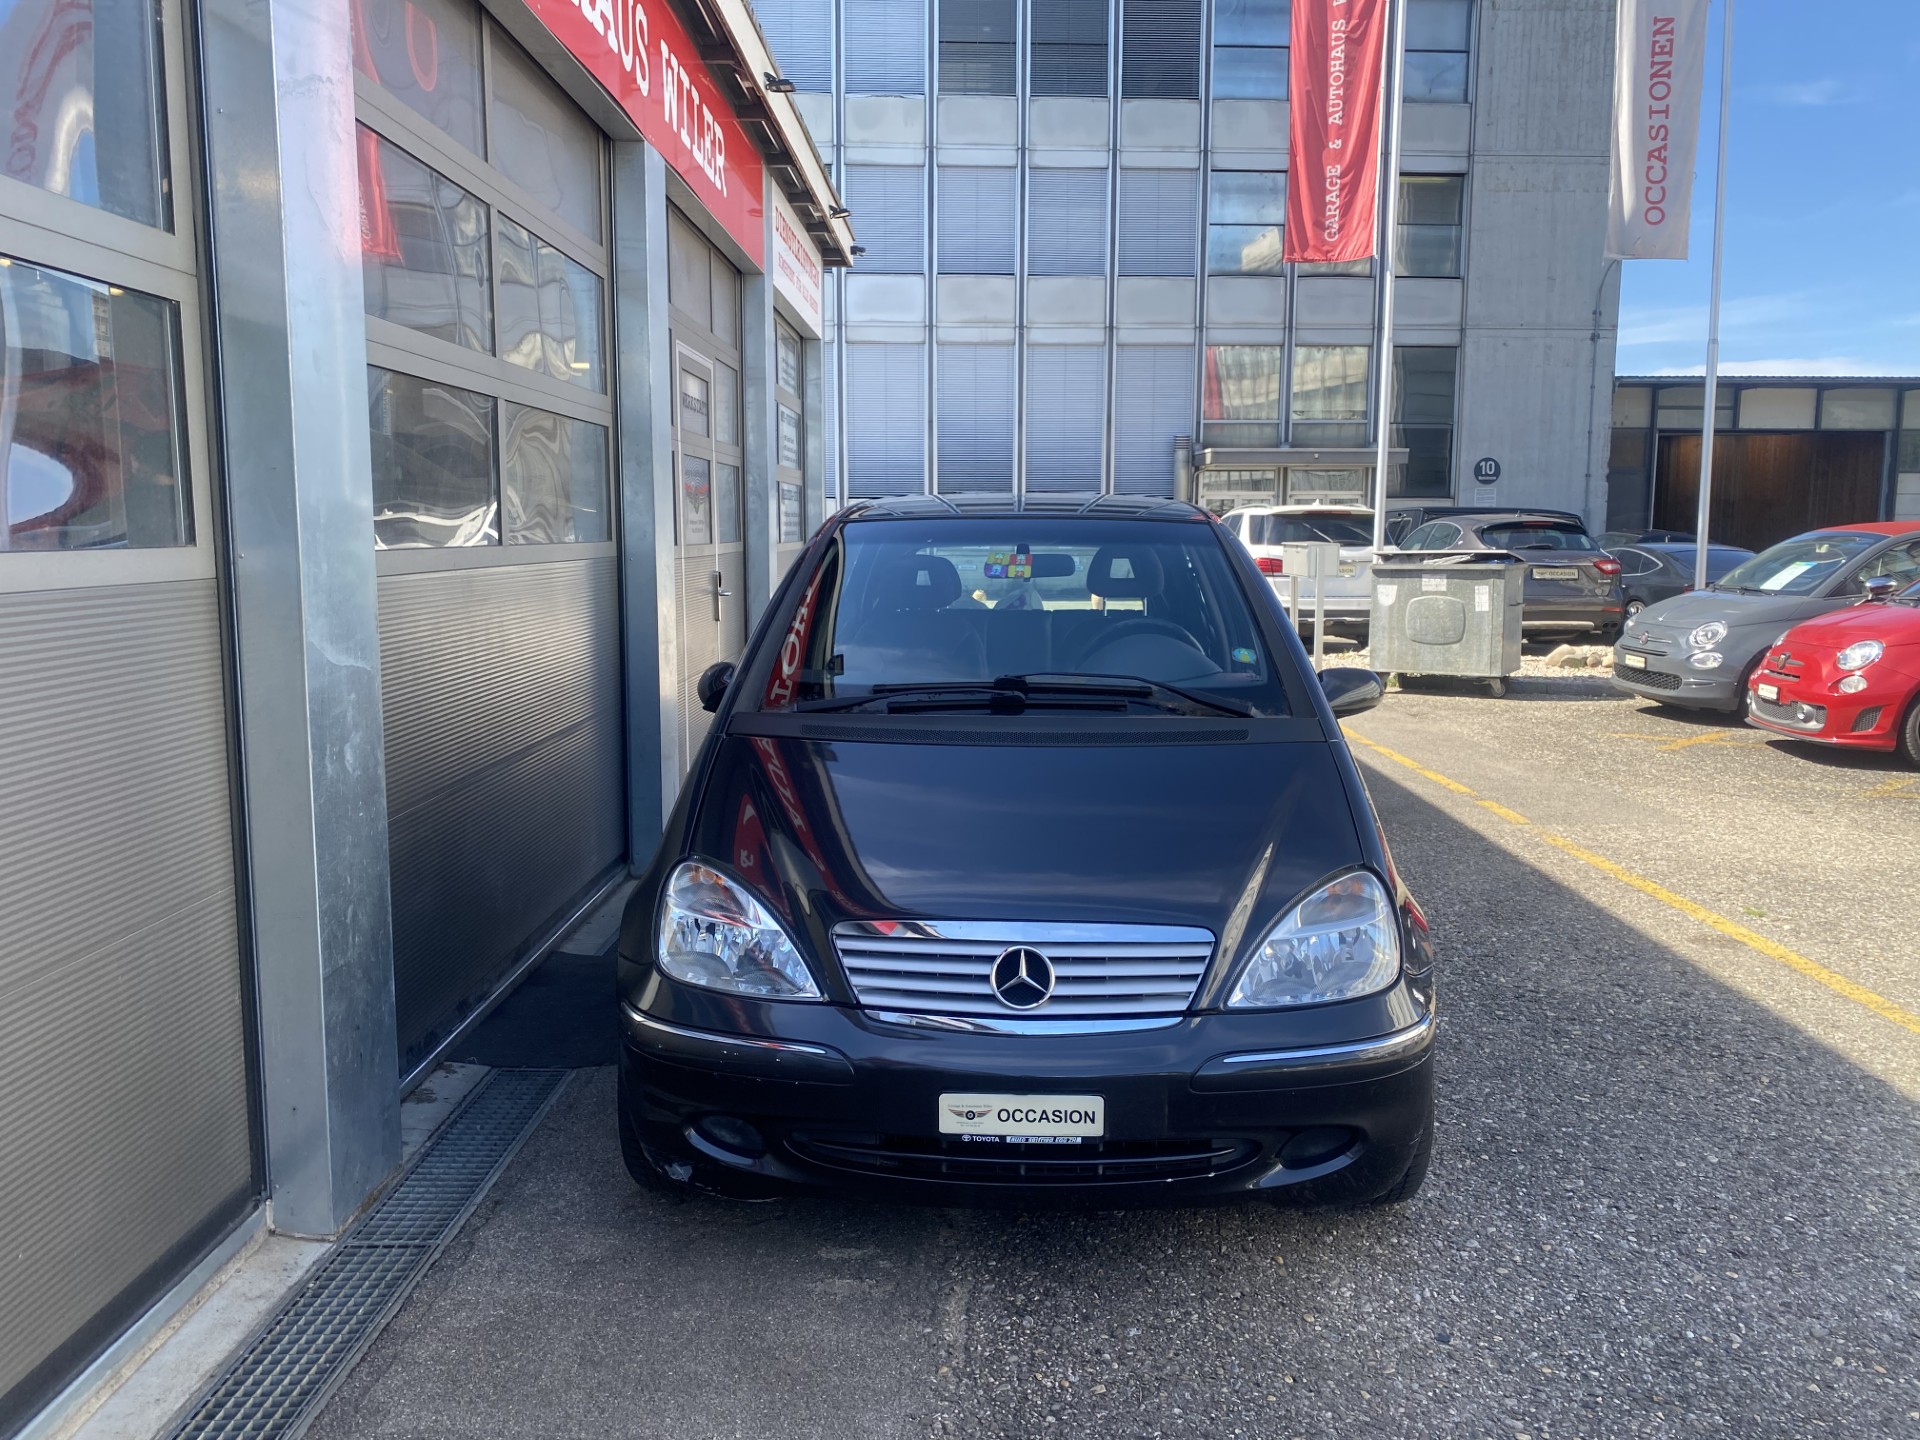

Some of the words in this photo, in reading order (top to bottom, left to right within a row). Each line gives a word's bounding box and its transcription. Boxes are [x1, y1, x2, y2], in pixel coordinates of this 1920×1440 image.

[1329, 18, 1347, 125] AUTOHAUS
[660, 38, 727, 198] WILER
[1329, 138, 1342, 149] &
[1643, 16, 1676, 226] OCCASIONEN
[1324, 164, 1341, 242] GARAGE
[1479, 460, 1495, 475] 10
[997, 1108, 1096, 1124] OCCASION
